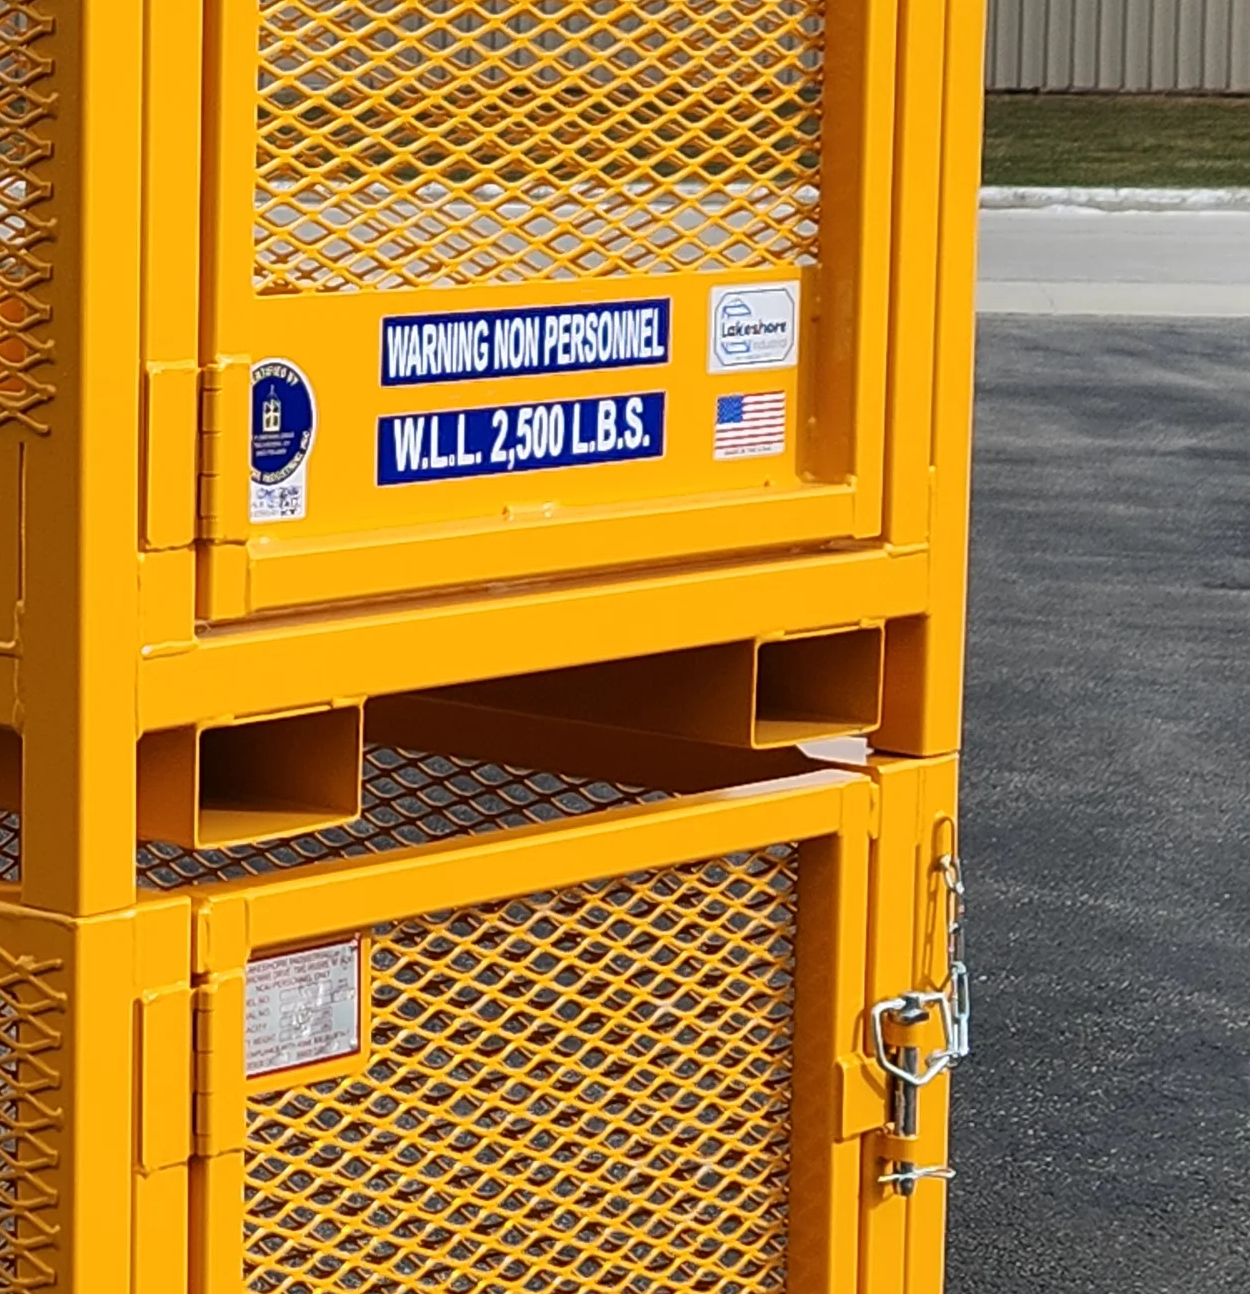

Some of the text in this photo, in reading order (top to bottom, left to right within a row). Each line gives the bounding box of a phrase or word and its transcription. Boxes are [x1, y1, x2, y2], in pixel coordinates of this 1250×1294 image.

[387, 307, 665, 378] WARNING NON PERSONNEL
[393, 396, 650, 472] W.L.L. 2,500 L.B.S.
